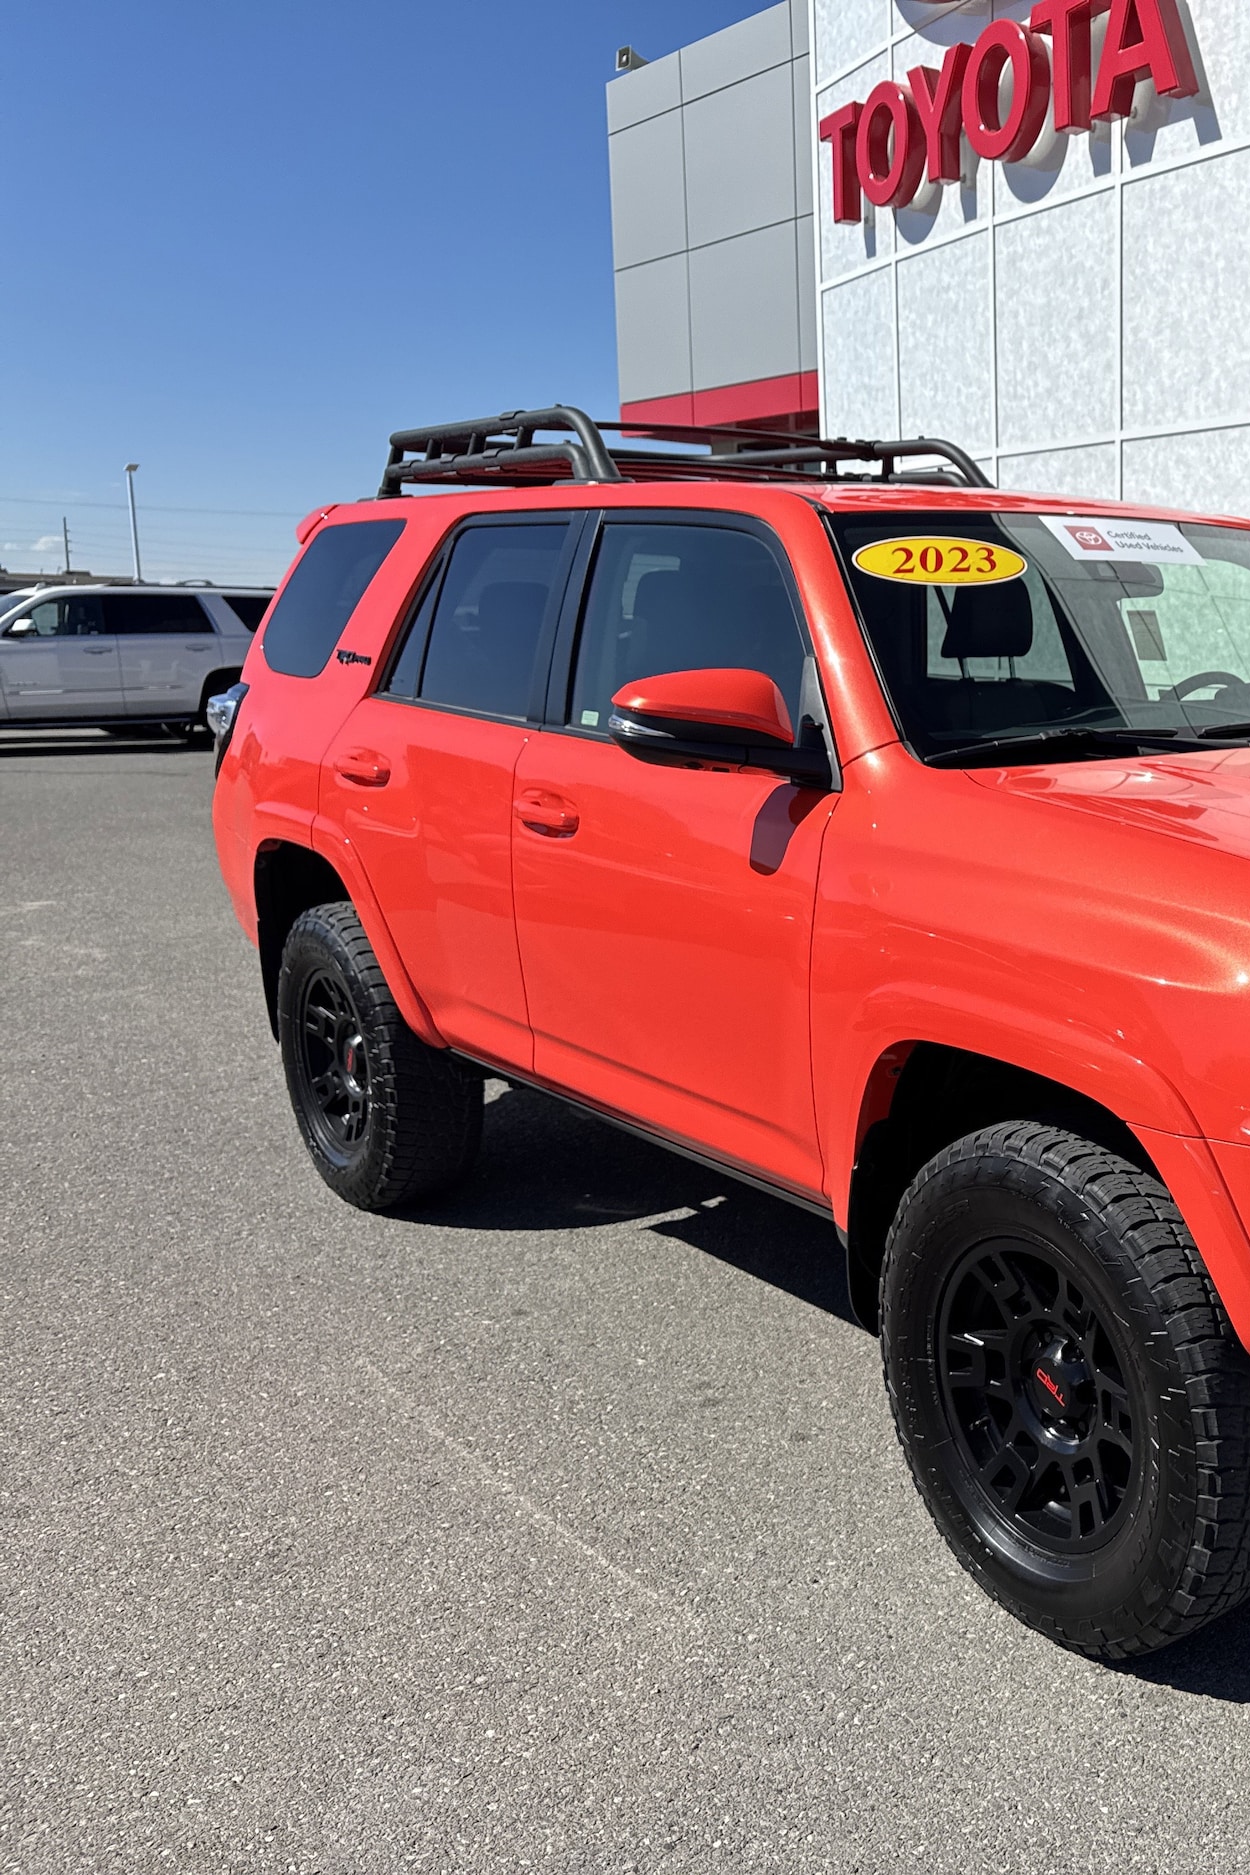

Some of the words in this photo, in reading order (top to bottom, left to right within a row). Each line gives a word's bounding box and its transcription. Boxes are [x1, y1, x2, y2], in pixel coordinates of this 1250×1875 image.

[819, 0, 1200, 226] TOYOTA
[1107, 530, 1152, 541] Certified
[1115, 540, 1143, 550] Used
[1143, 542, 1184, 553] Vehicles
[891, 546, 998, 574] 2023
[1036, 1367, 1066, 1408] TRD
